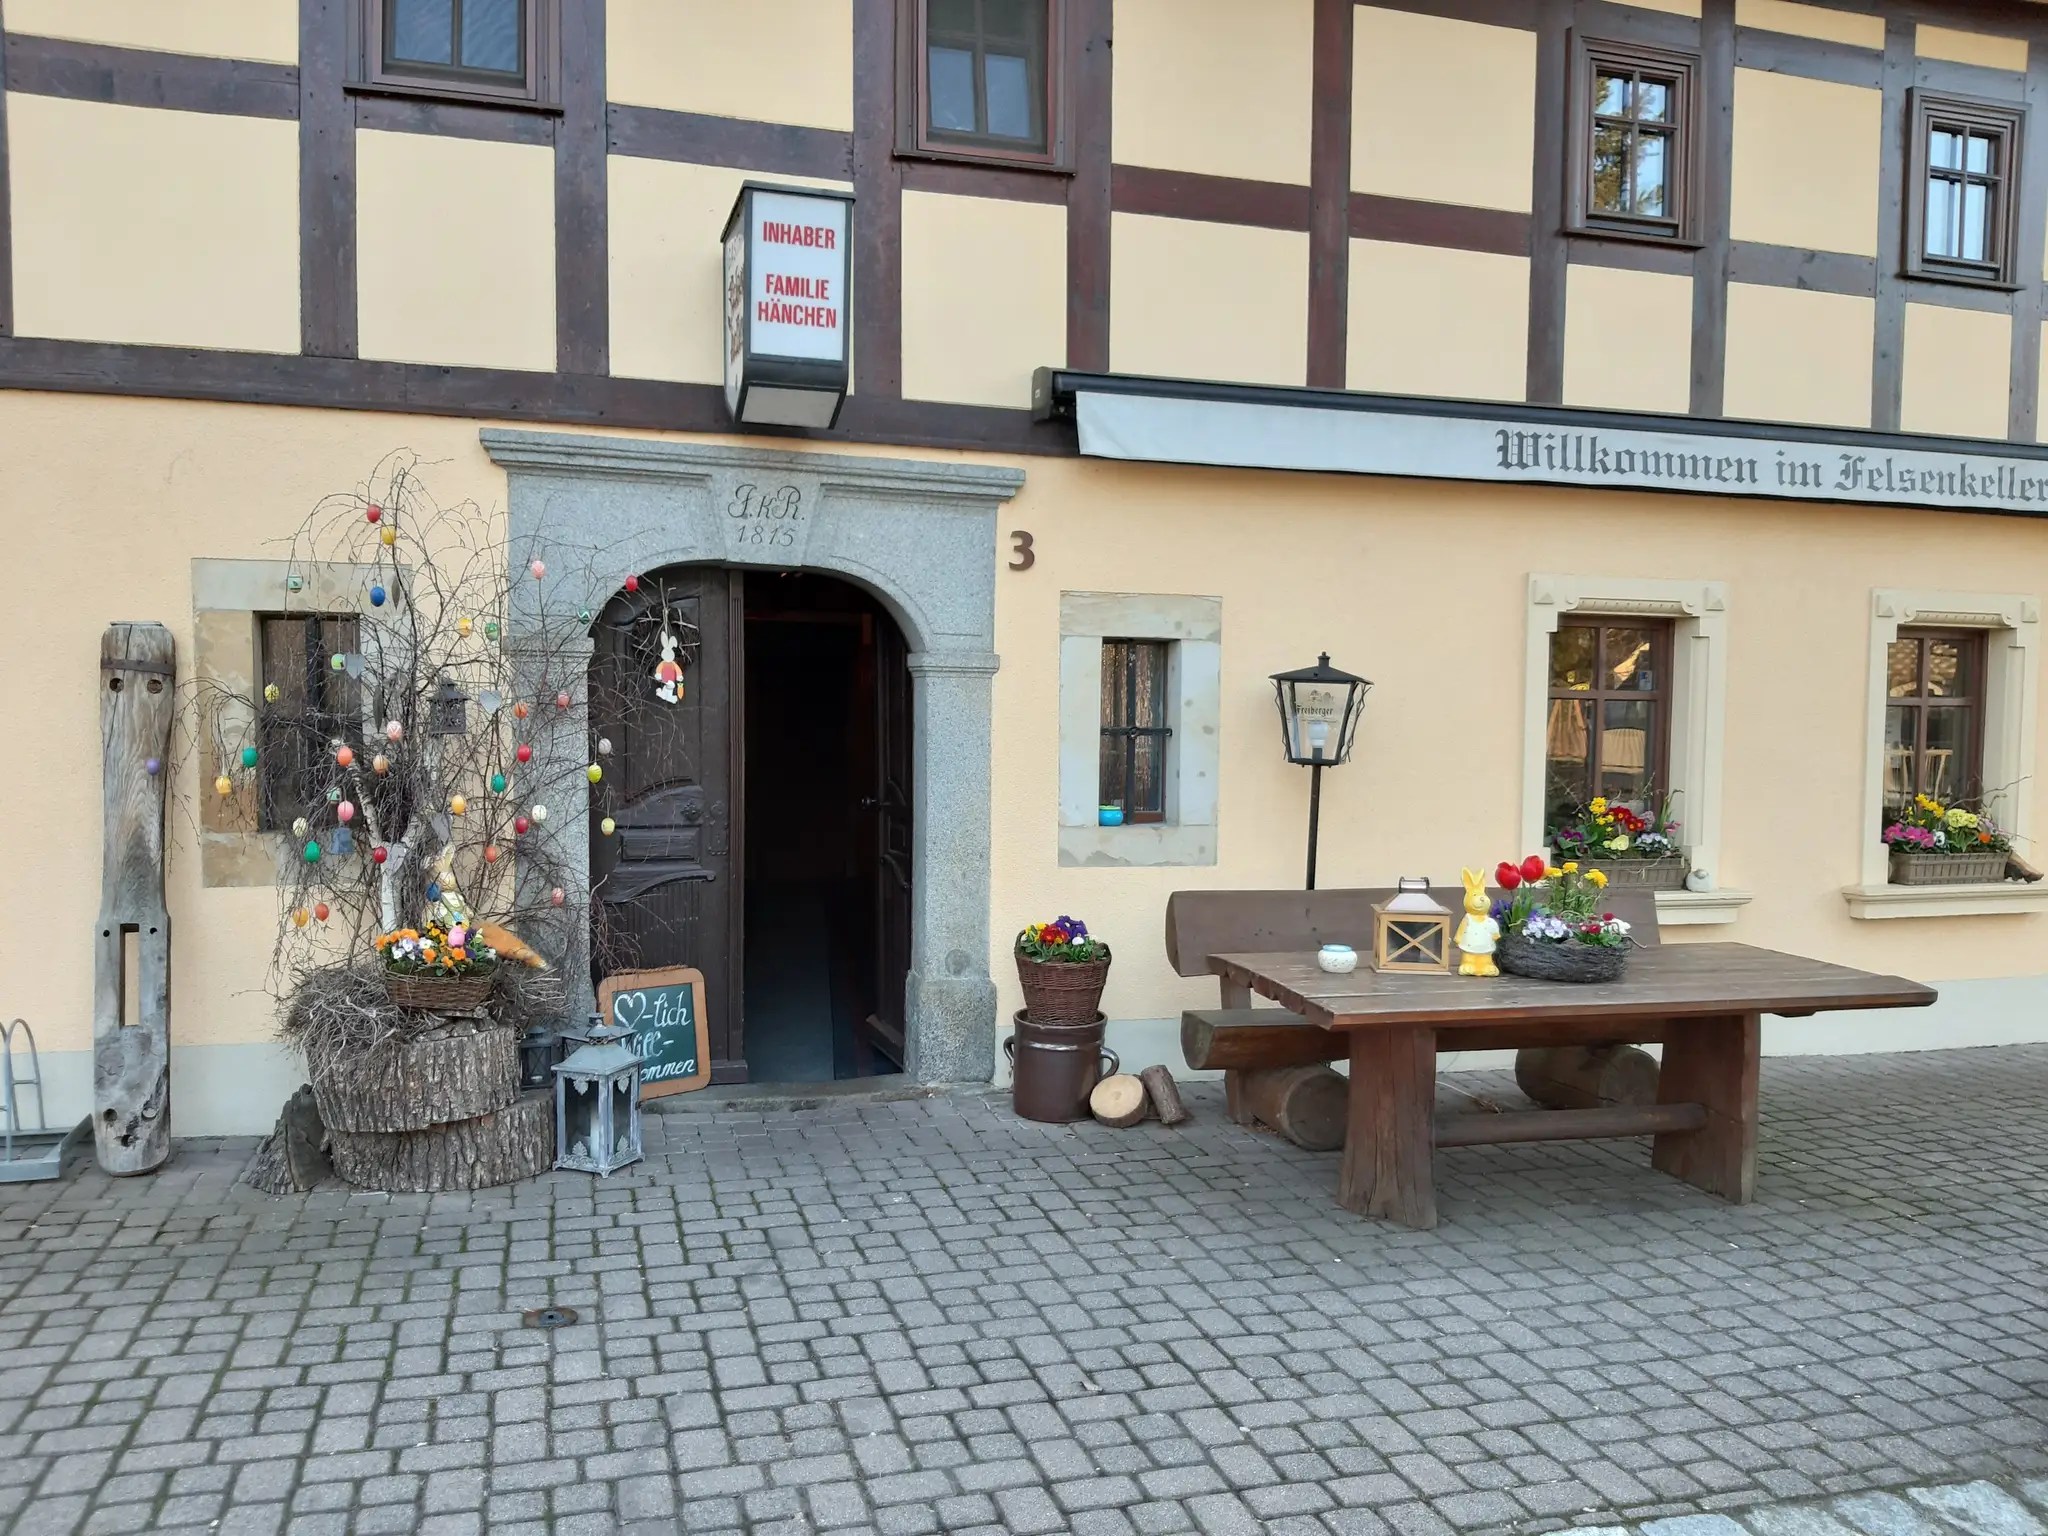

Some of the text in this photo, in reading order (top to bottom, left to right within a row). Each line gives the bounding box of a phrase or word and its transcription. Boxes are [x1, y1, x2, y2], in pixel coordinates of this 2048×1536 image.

[763, 221, 836, 250] INHABER
[765, 273, 830, 301] FAMILIE
[757, 298, 837, 329] HÄNCHEN
[1495, 429, 2048, 502] Willkommen im Felsenkeller
[737, 525, 797, 547] 1815
[1008, 530, 1036, 572] 3
[1296, 704, 1334, 717] Freiberger
